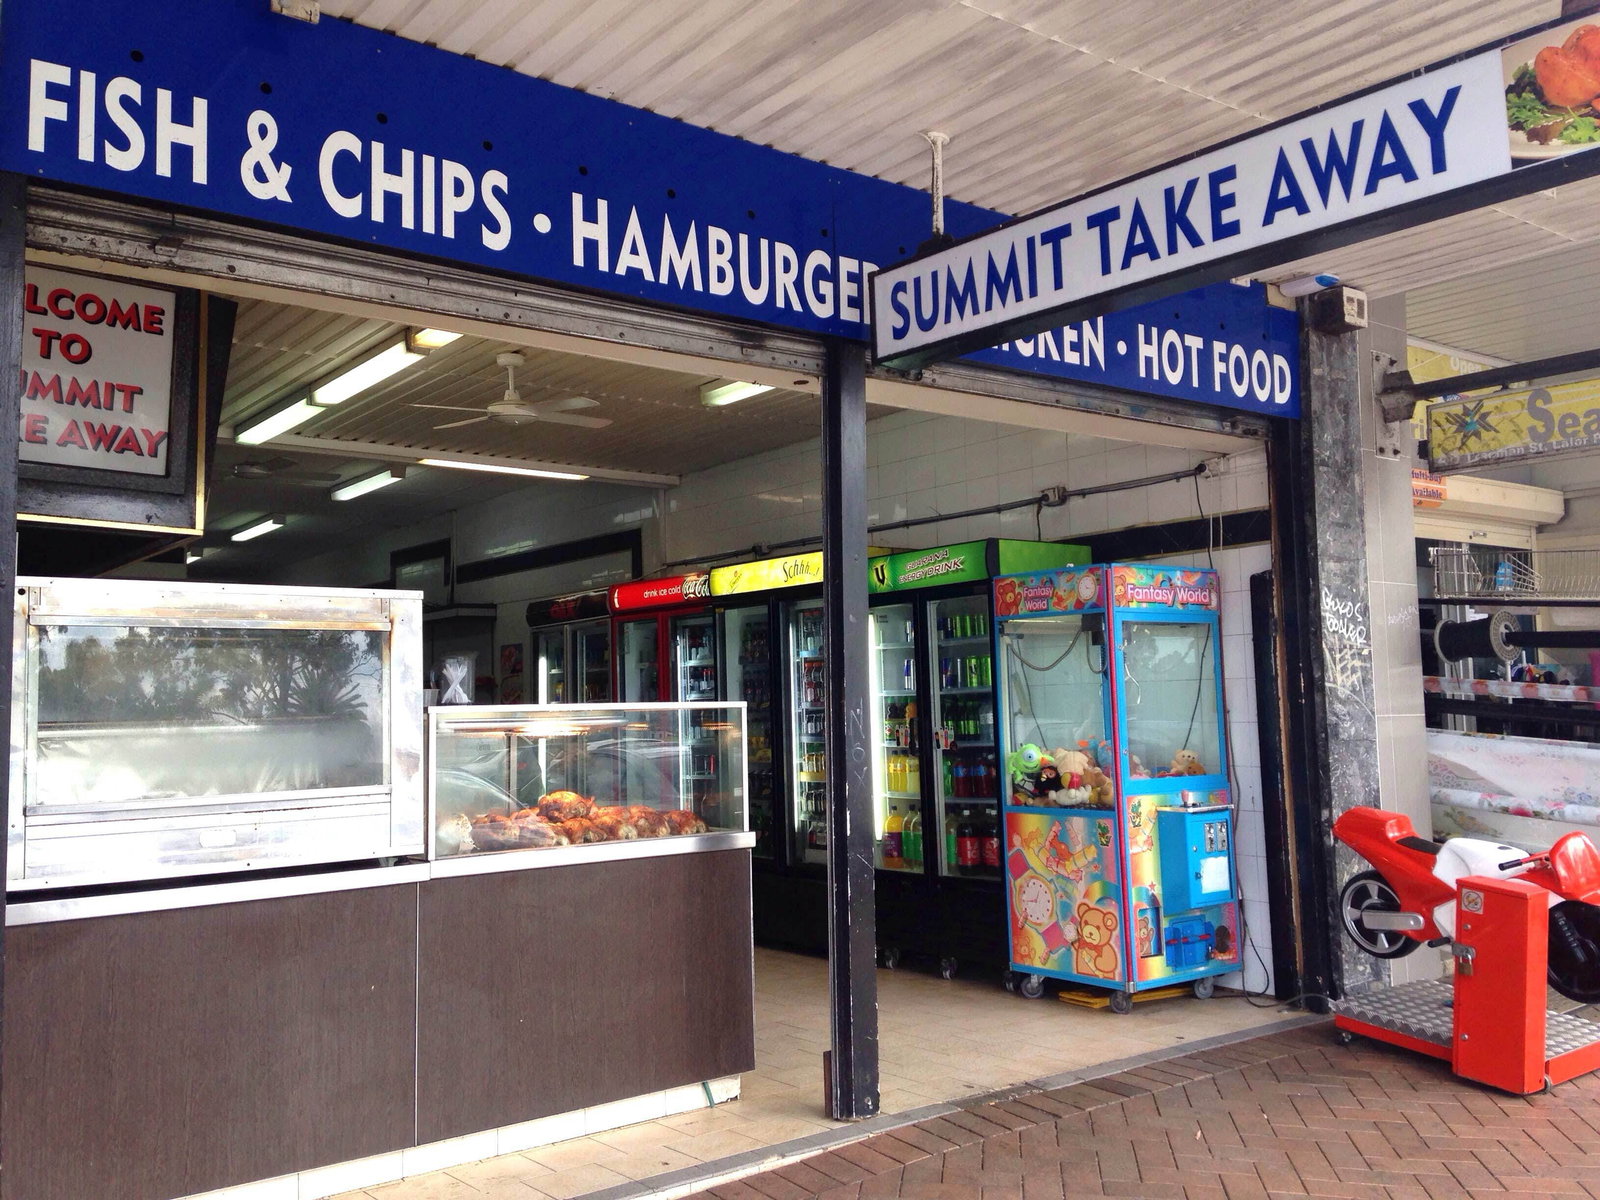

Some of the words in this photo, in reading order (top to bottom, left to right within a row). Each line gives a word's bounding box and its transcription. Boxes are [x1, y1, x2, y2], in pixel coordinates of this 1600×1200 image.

[28, 58, 208, 186] FISH
[240, 110, 293, 203] &
[319, 130, 511, 252] CHIPS
[891, 223, 1073, 340] SUMMIT
[1086, 164, 1241, 277] TAKE
[1262, 85, 1462, 227] AWAY
[32, 328, 92, 364] TO
[1138, 323, 1203, 388] HOT
[1213, 340, 1292, 404] FOOD
[56, 419, 167, 458] AWAY
[905, 549, 949, 571] GUARANA
[926, 556, 966, 577] DRINK
[643, 586, 658, 598] drink
[1023, 586, 1054, 598] Fantasy
[1127, 584, 1176, 604] Fantasy
[1176, 588, 1209, 602] World
[1025, 599, 1047, 610] World
